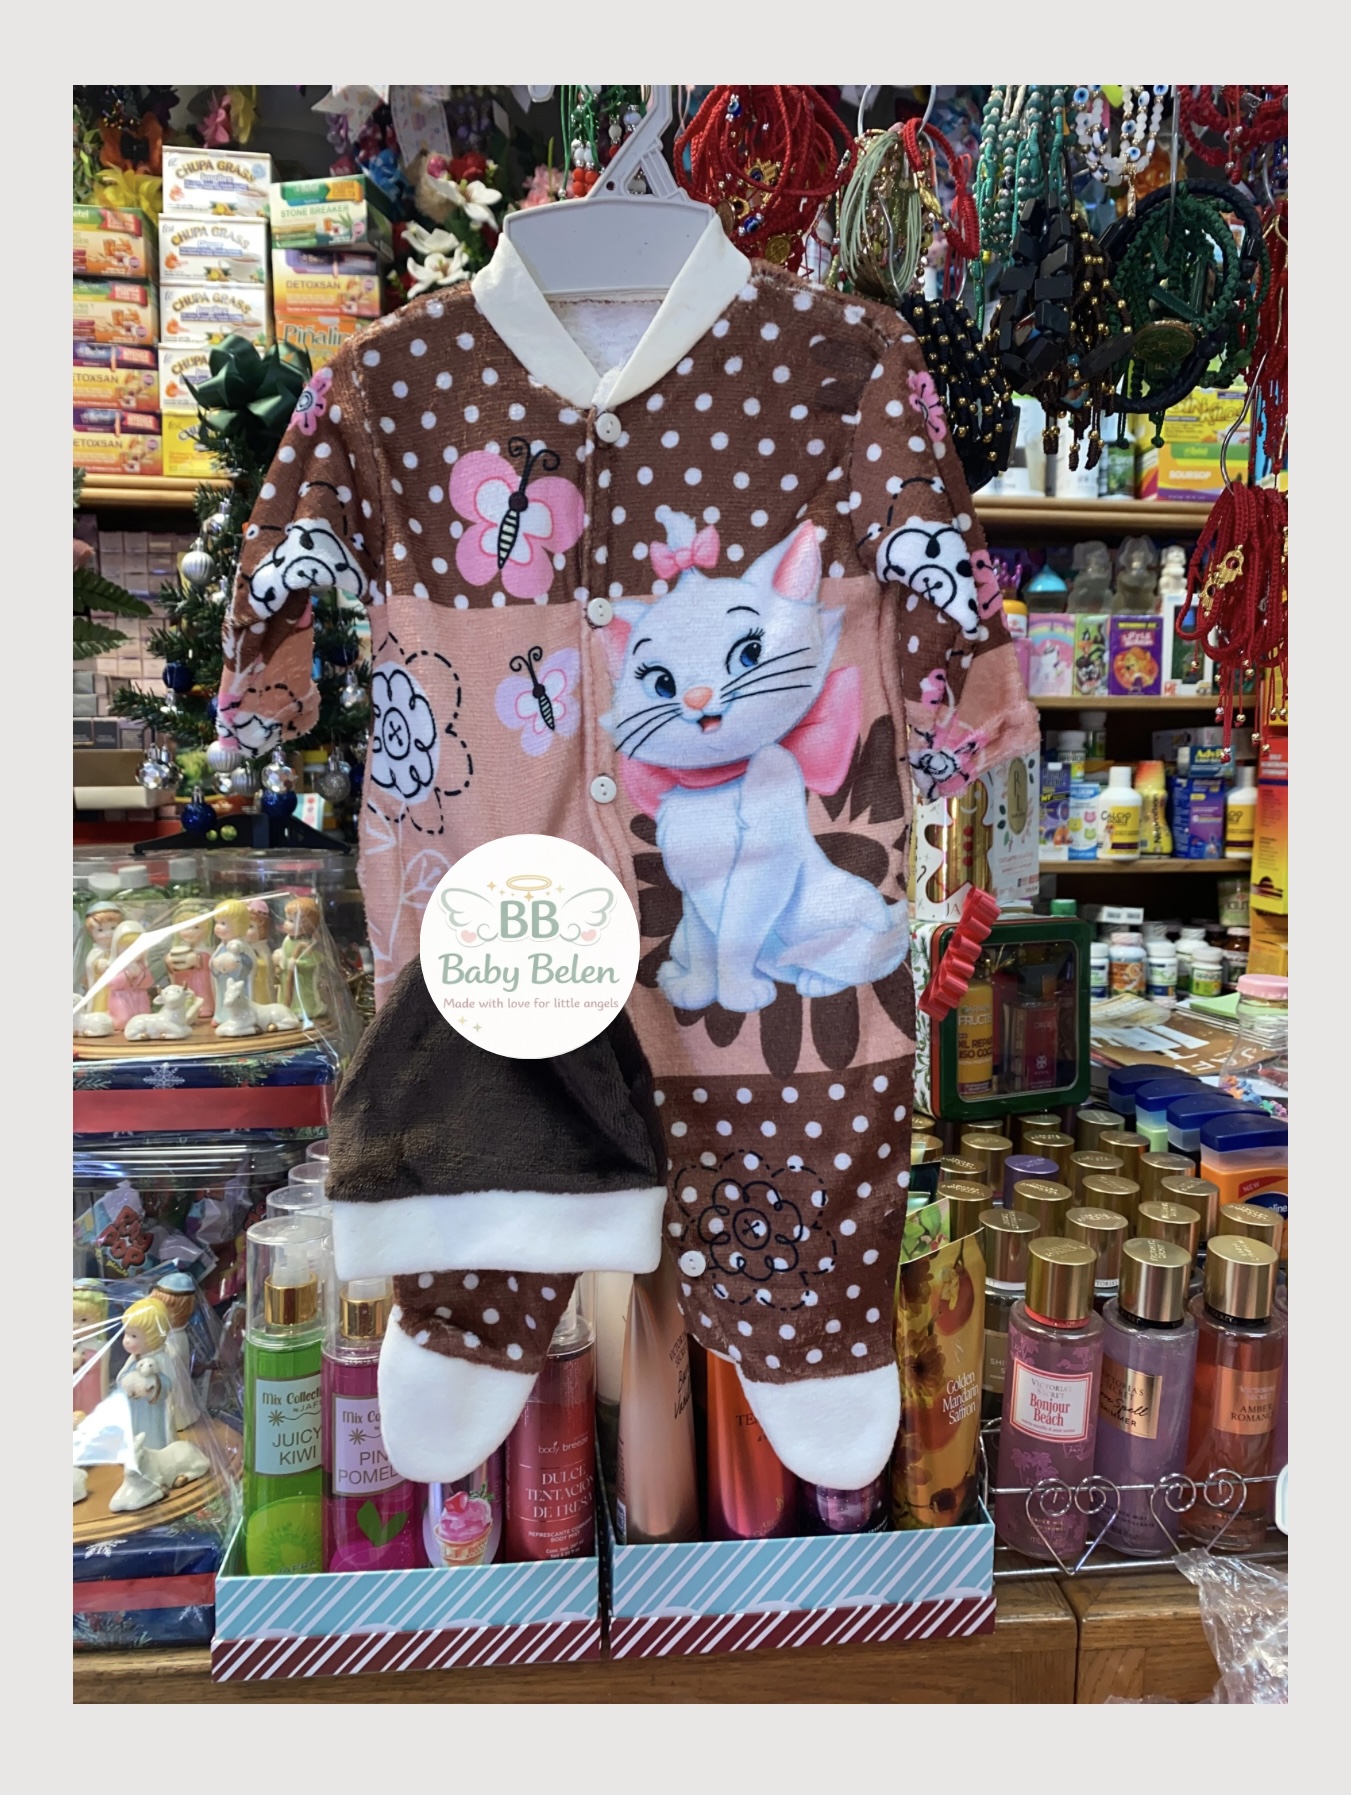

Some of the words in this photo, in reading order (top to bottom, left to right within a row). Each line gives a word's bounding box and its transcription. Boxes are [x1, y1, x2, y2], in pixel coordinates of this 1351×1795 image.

[175, 159, 215, 179] CHUPA
[217, 161, 256, 183] GRASS
[281, 207, 307, 218] STONE
[309, 204, 350, 215] BREAKER
[171, 226, 209, 246] CHUPA
[211, 227, 250, 249] GRASS
[285, 280, 341, 290] DETOXSAN
[172, 293, 211, 313] CHUPA
[212, 293, 252, 315] GRASS
[171, 355, 211, 375] CHUPA
[1169, 470, 1212, 481] SOURSOP
[1242, 1180, 1261, 1193] NEW
[990, 1358, 1005, 1366] SHI
[947, 1371, 975, 1395] Golden
[262, 1392, 282, 1405] Mix
[300, 1400, 321, 1412] JAF
[943, 1384, 979, 1413] Mandarin
[1030, 1393, 1071, 1415] Bonjour
[1113, 1398, 1149, 1417] Spell
[1240, 1403, 1272, 1413] AMBER
[342, 1411, 363, 1424] Mix
[367, 1411, 381, 1422] Co
[949, 1401, 976, 1424] Saffron
[1033, 1411, 1064, 1427] Beach
[1231, 1411, 1273, 1422] ROMANC
[272, 1425, 321, 1448] JUICY
[539, 1443, 560, 1455] body
[562, 1436, 589, 1452] breeze
[279, 1445, 316, 1466] KIWI
[359, 1450, 388, 1466] PIN
[338, 1466, 398, 1485] POMEL
[542, 1464, 586, 1485] DULCE
[534, 1506, 552, 1519] DE
[557, 1492, 594, 1518] FRESA
[528, 1529, 571, 1538] REFRESCANTE
[550, 1535, 567, 1543] BODY
[568, 1530, 580, 1539] MIST
